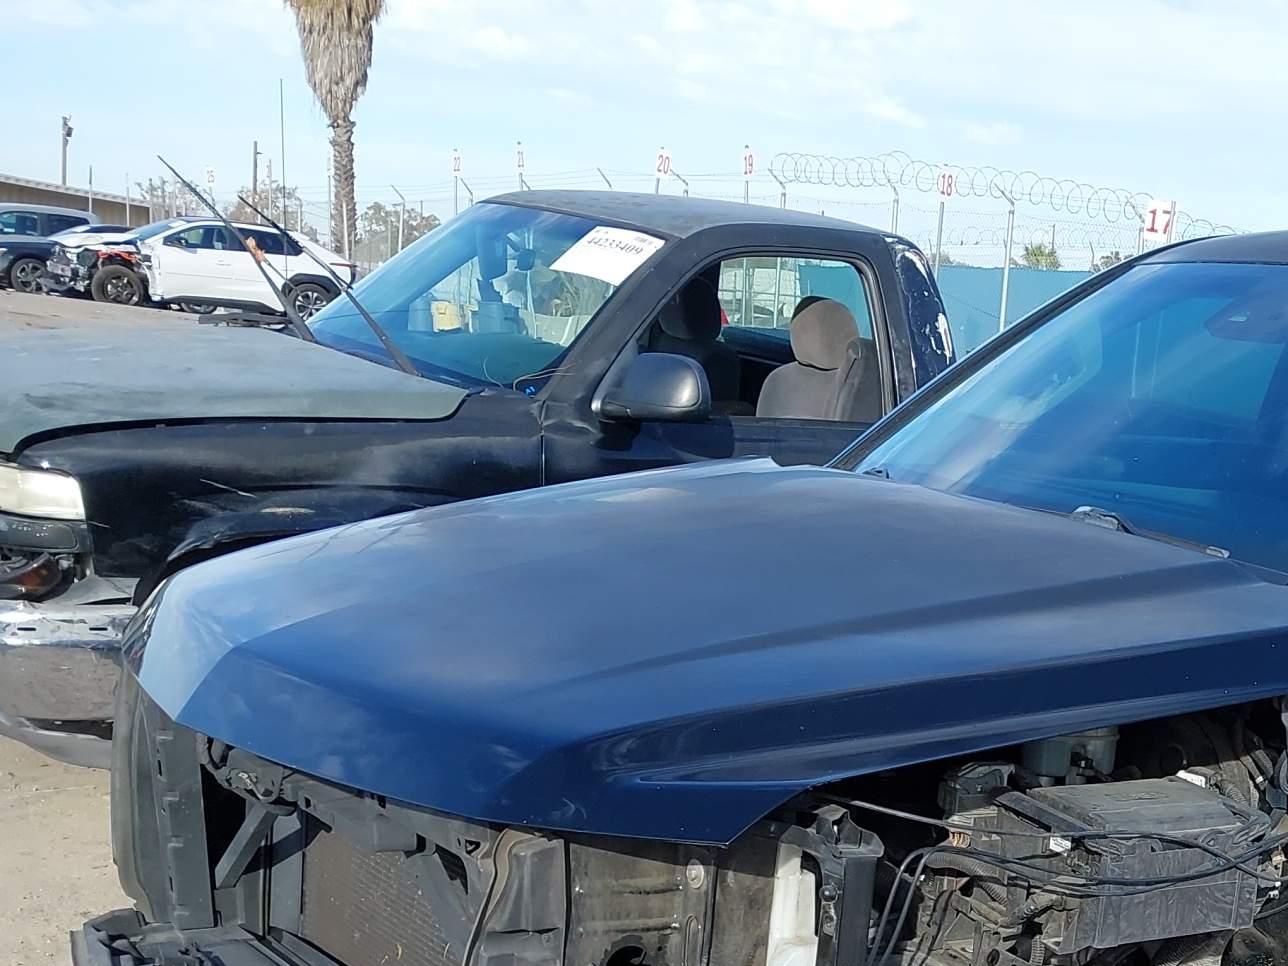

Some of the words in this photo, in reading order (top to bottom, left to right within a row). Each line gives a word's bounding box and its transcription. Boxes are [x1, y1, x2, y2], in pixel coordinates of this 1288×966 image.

[657, 154, 670, 175] 20
[744, 154, 753, 175] 19
[940, 173, 953, 197] 18
[1146, 208, 1176, 235] 17
